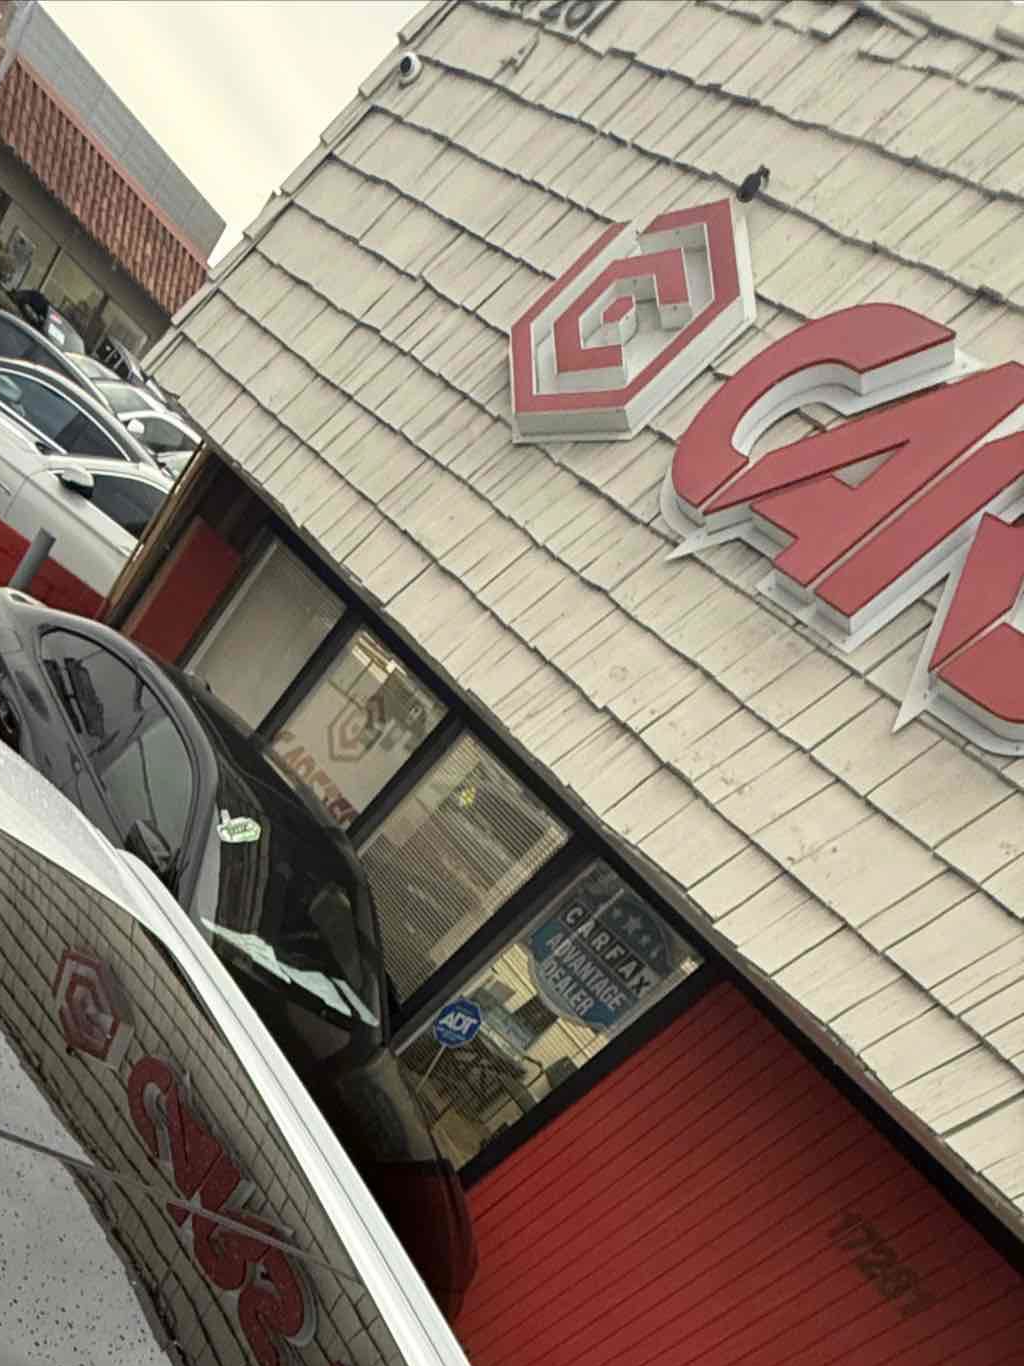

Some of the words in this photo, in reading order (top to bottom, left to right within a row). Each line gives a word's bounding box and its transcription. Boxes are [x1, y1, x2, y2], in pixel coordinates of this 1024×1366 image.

[546, 931, 626, 1009] ADVANTAGE
[565, 906, 652, 995] CARFAX
[543, 957, 594, 1017] DEALER
[438, 1011, 478, 1035] ADT
